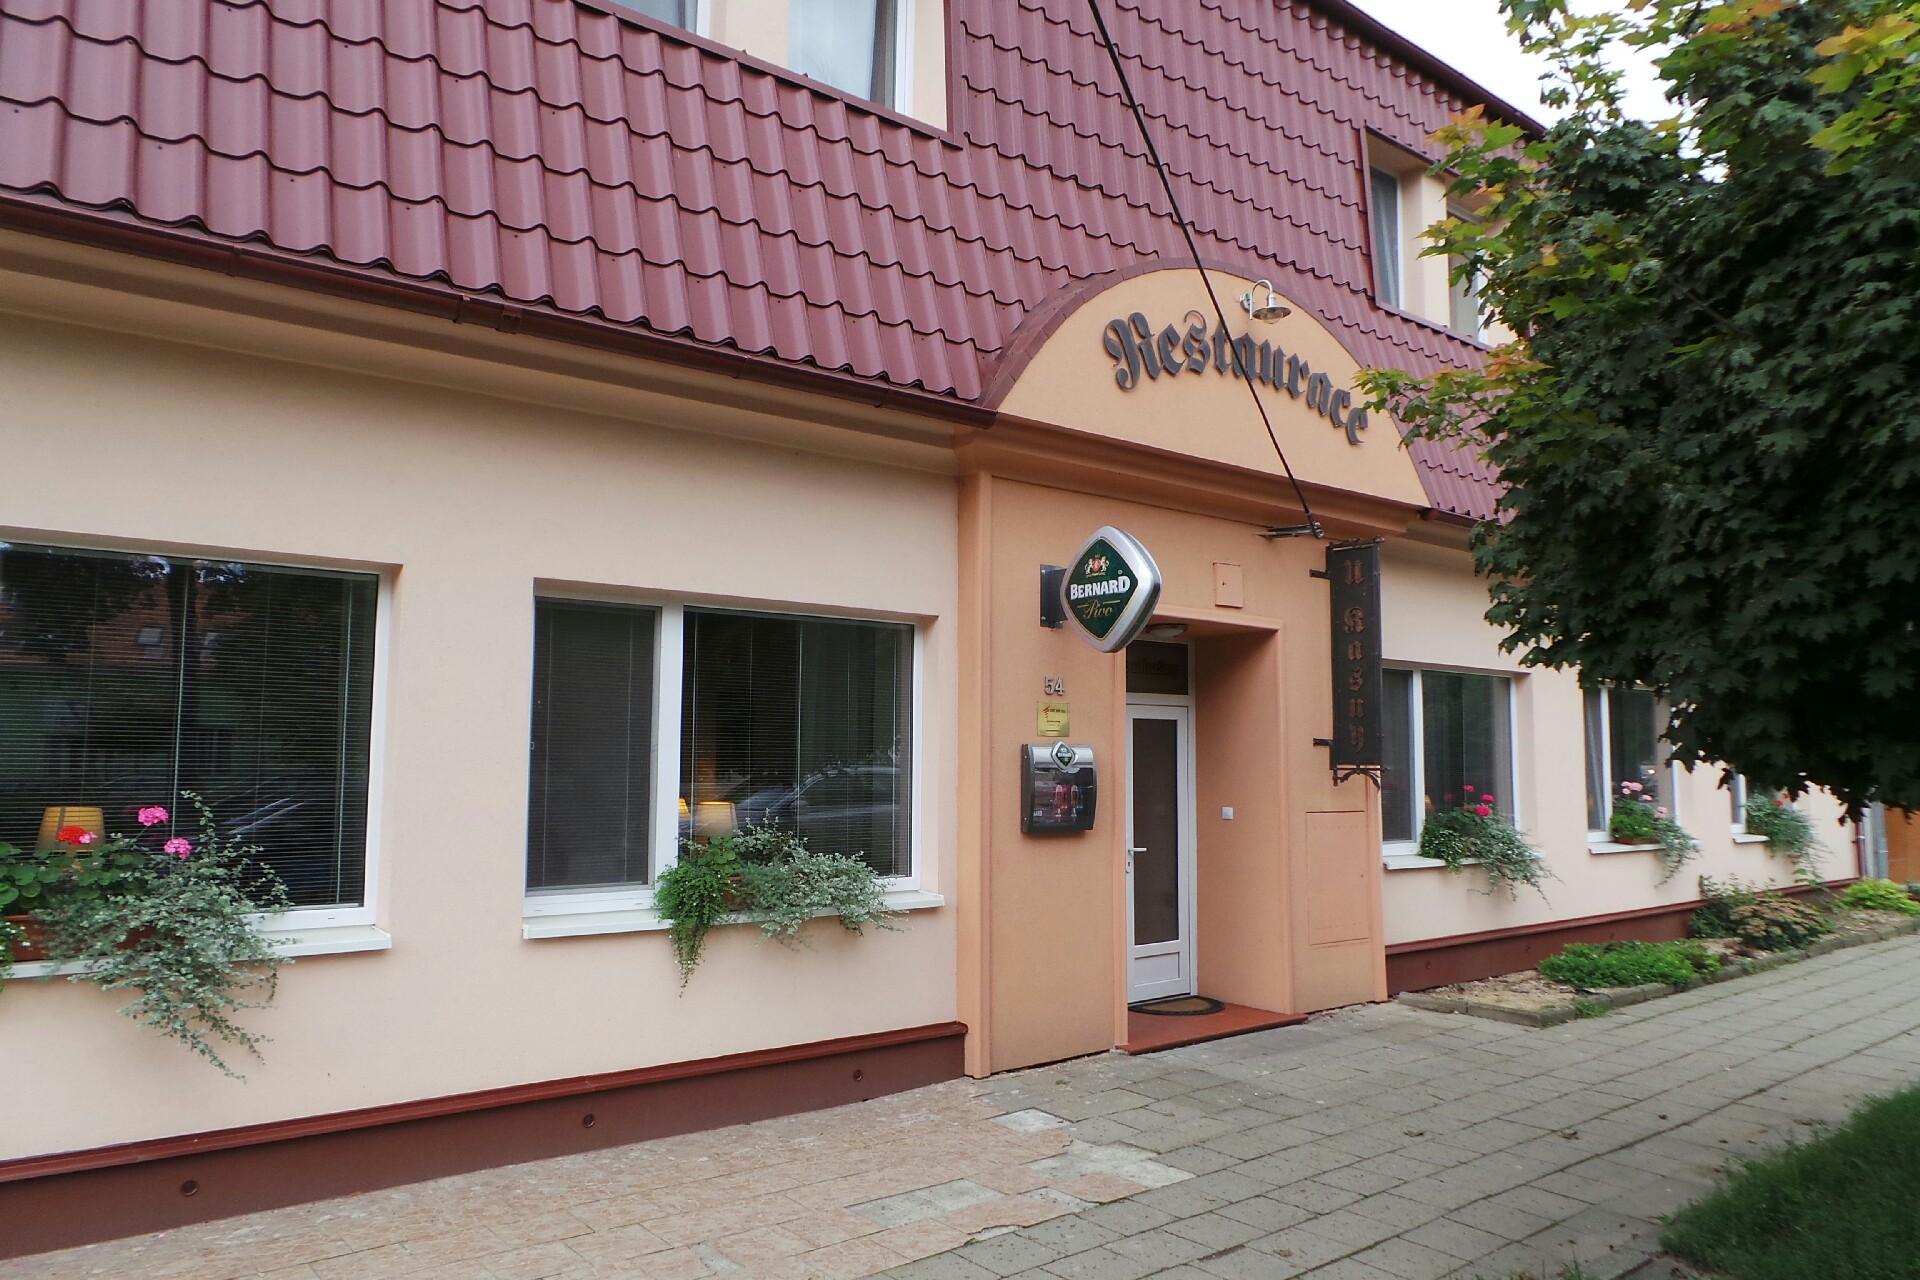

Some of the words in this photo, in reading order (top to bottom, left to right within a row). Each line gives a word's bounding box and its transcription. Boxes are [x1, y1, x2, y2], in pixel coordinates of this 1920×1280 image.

[1103, 310, 1369, 446] Restaurace
[1070, 575, 1131, 600] BERNARD
[1082, 600, 1113, 619] Pivo
[1044, 675, 1065, 696] 54
